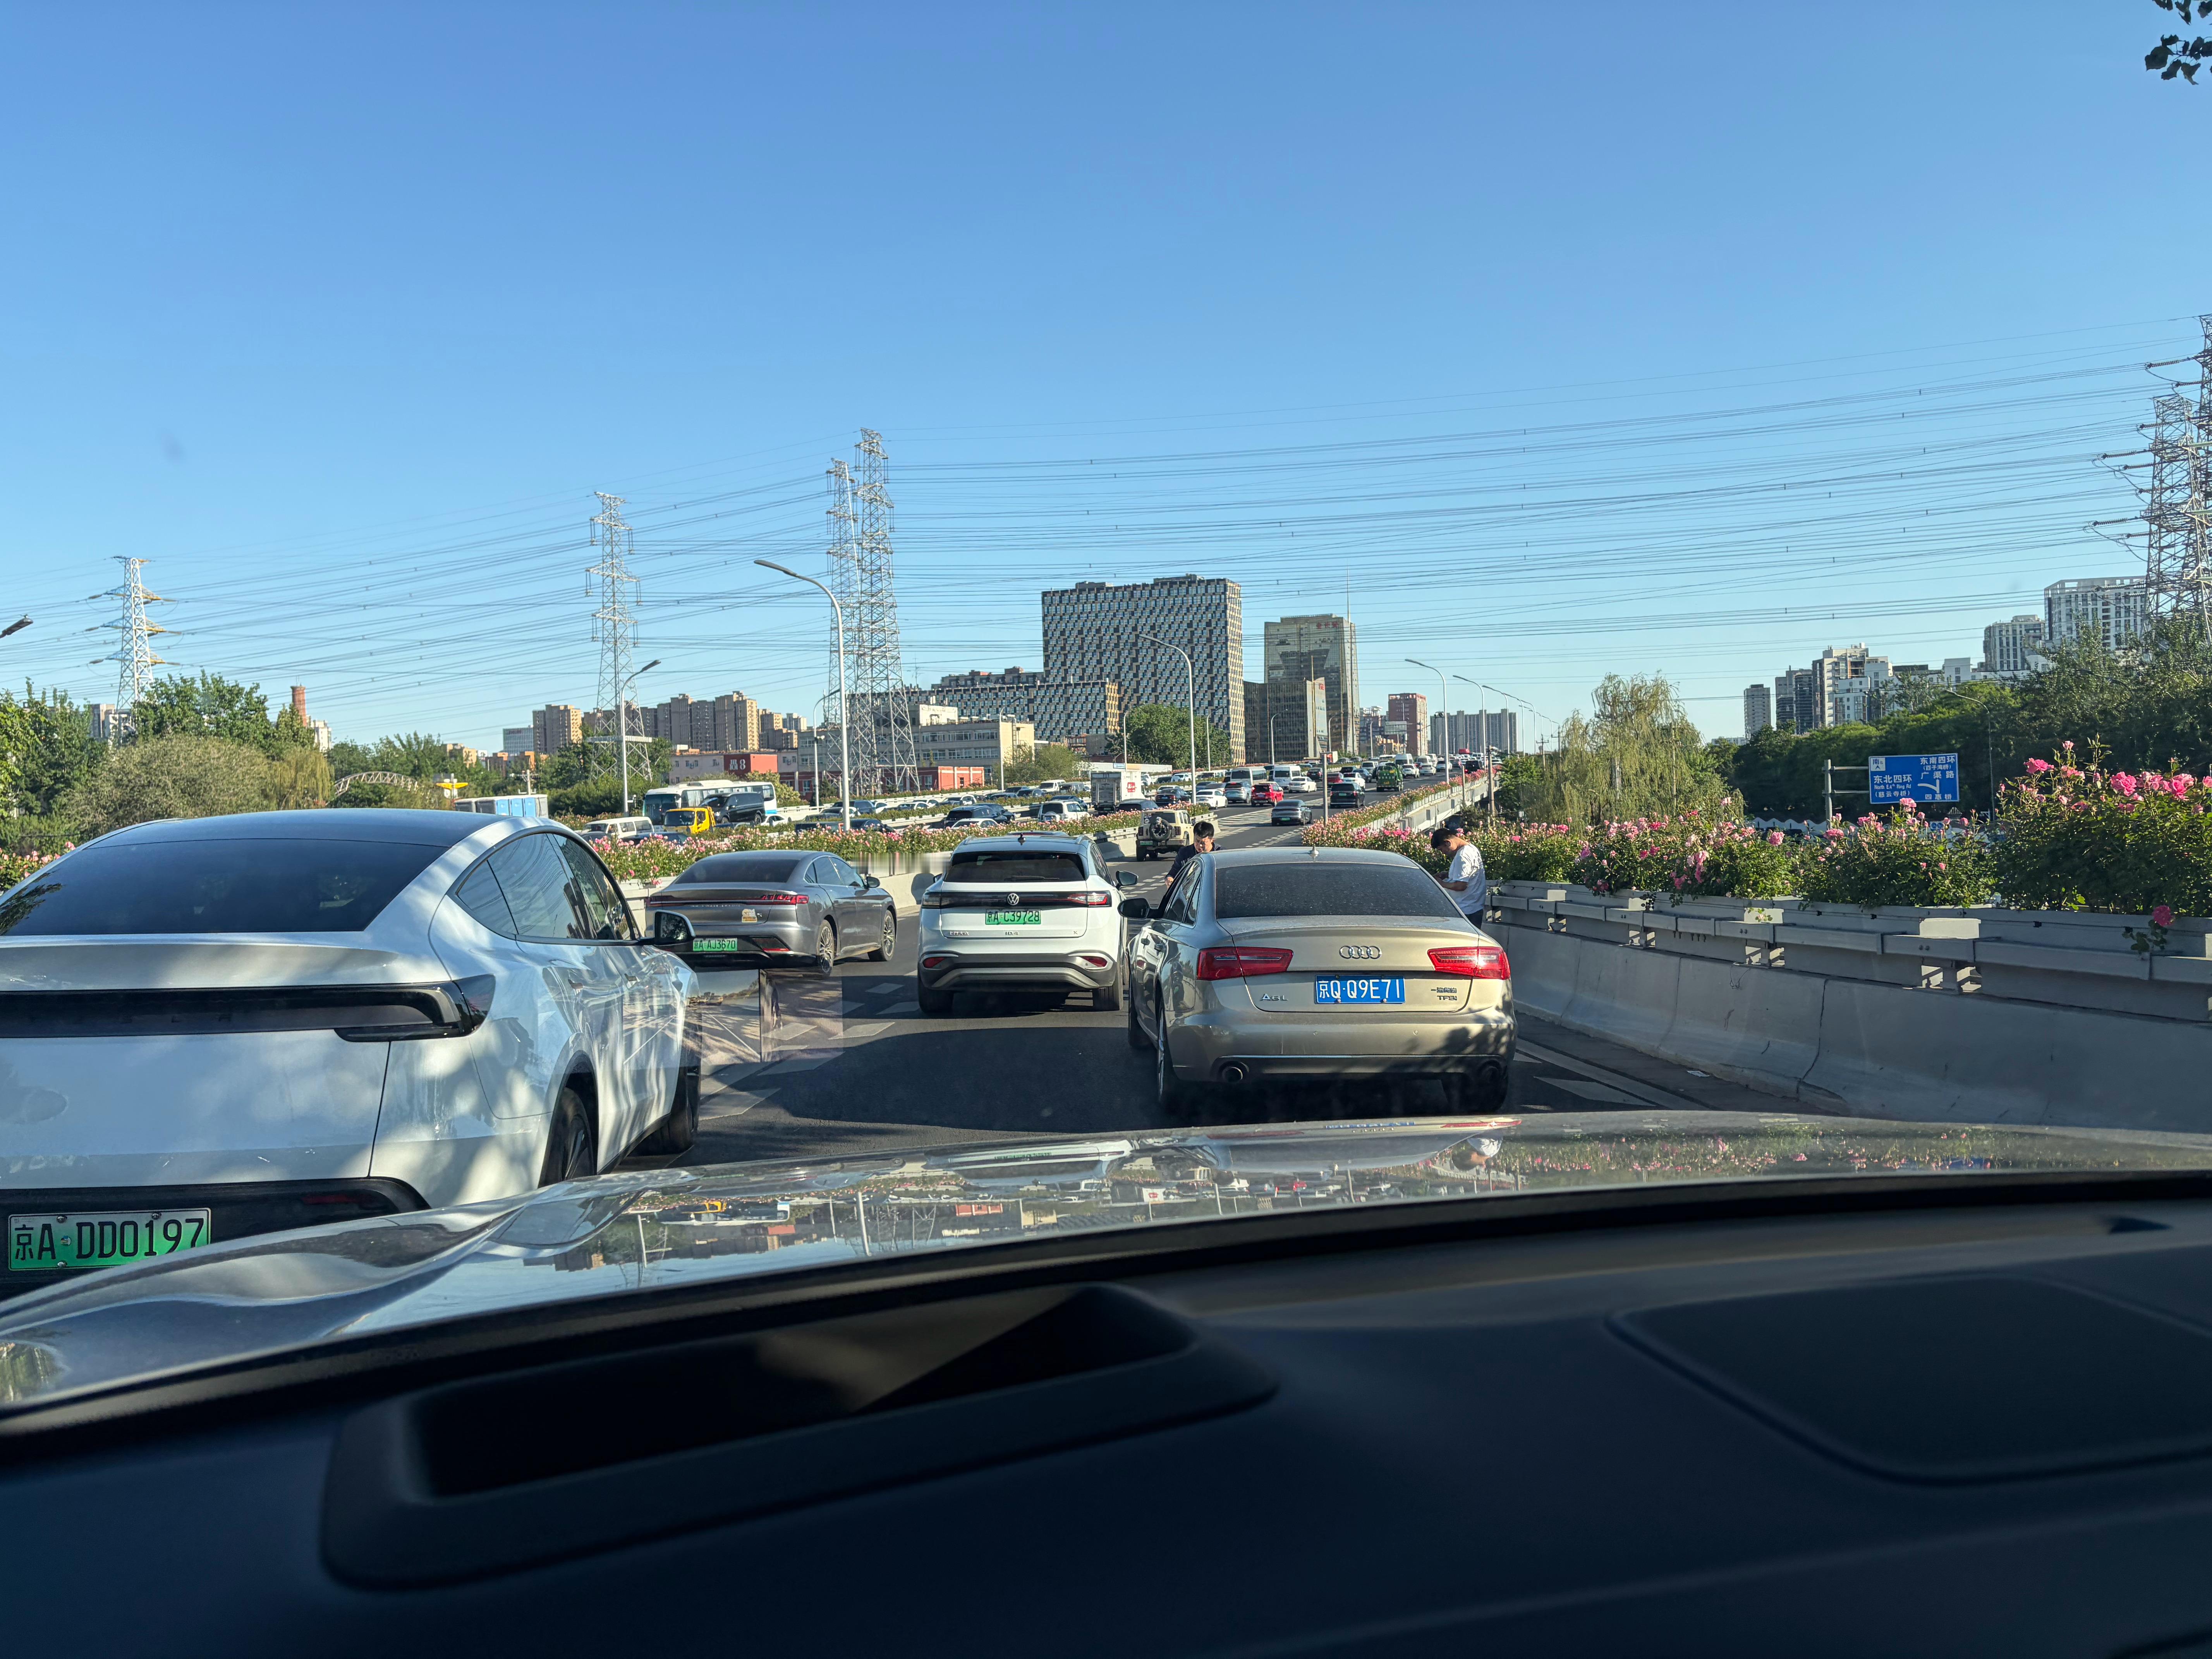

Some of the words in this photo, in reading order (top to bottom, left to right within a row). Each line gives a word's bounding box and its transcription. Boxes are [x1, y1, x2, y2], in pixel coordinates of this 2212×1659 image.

[1920, 756, 1955, 765] 东南四环
[1873, 774, 1912, 784] 东北四环
[1921, 771, 1954, 780] 广渠路
